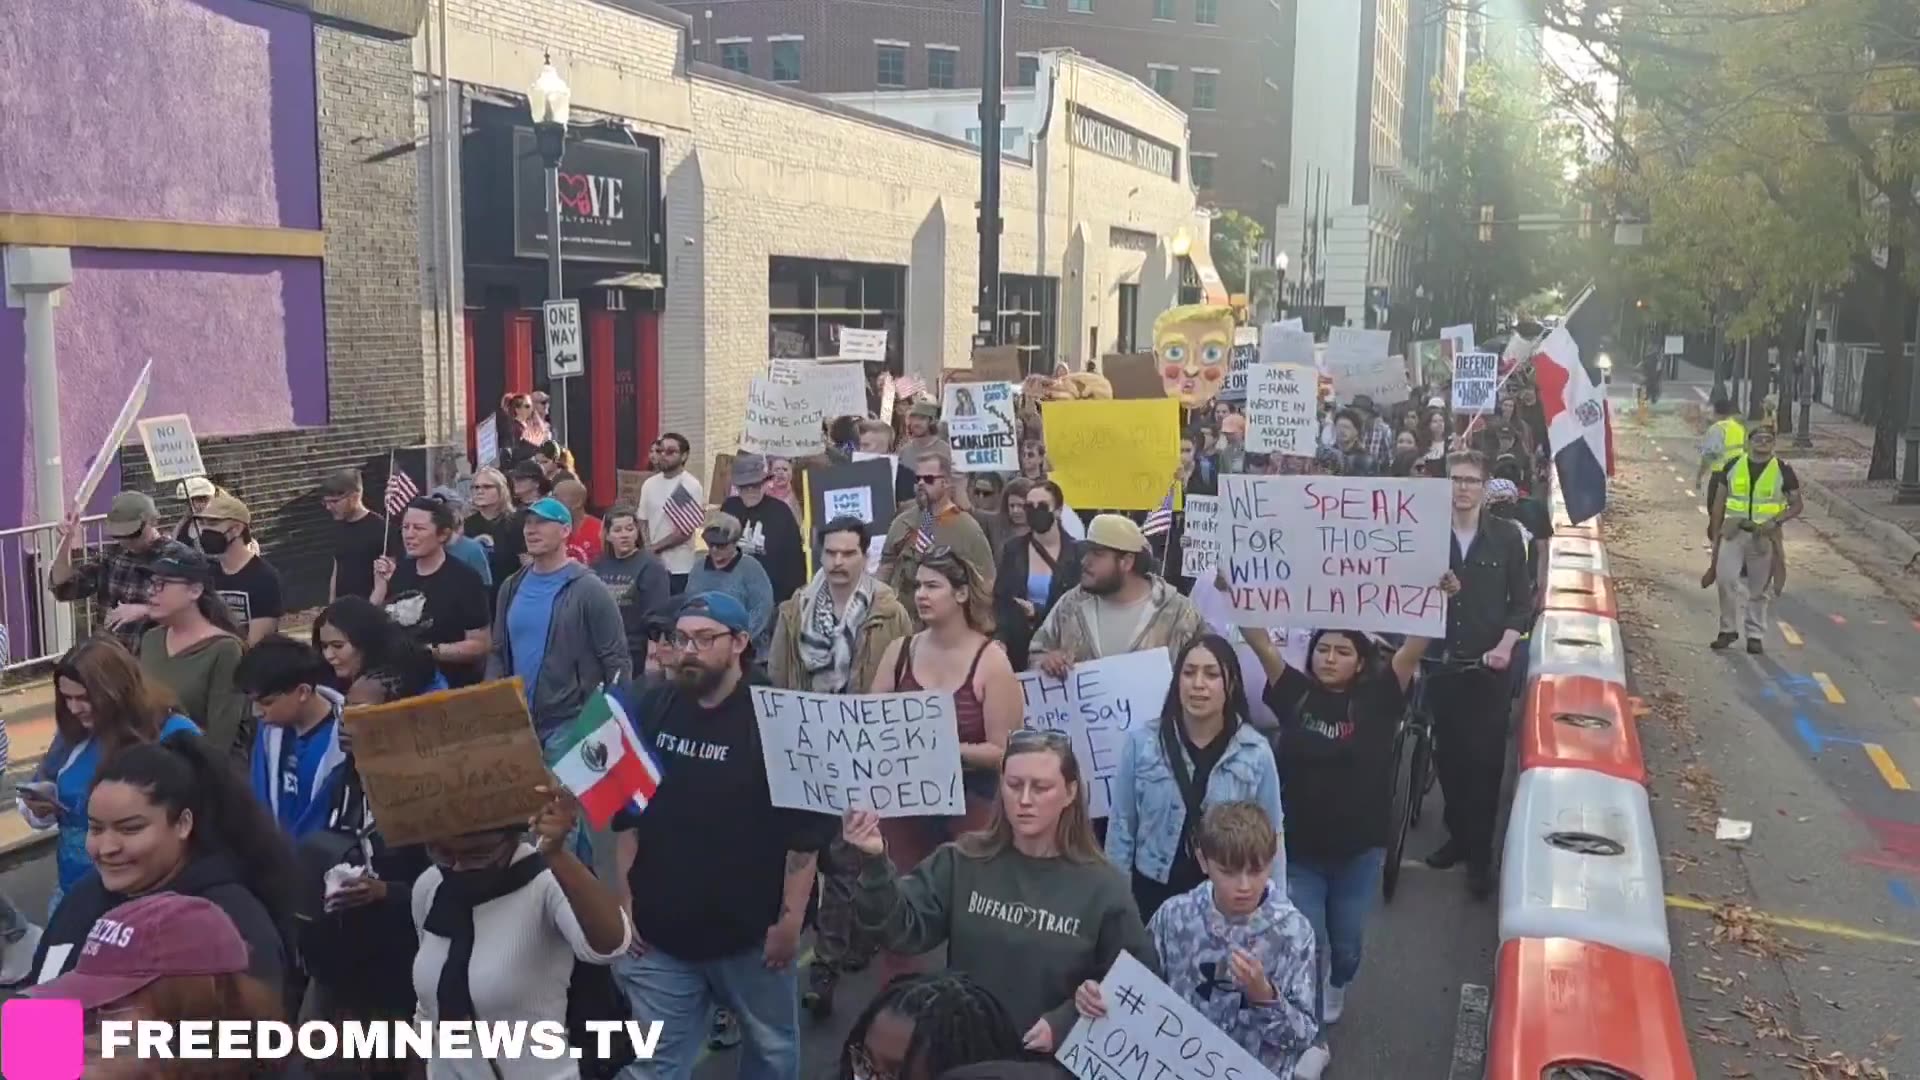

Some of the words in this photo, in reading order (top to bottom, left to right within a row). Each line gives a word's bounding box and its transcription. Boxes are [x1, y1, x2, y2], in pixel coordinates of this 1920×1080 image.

[1071, 112, 1133, 161] NORTHSIDE
[1136, 138, 1174, 177] STATION
[549, 306, 575, 326] ONE
[550, 327, 576, 347] WAY
[1265, 368, 1296, 380] ANNE
[1456, 355, 1495, 370] DEFEND
[1258, 383, 1300, 395] FRANK
[1249, 398, 1289, 412] WROTE
[1293, 401, 1306, 413] IN
[1249, 415, 1273, 425] HER
[1277, 416, 1311, 427] DIARY
[1261, 427, 1296, 437] ABOUT
[1262, 437, 1296, 451] THIS!
[1227, 480, 1277, 521] WE
[1231, 525, 1285, 554] FOR
[1315, 526, 1416, 553] THOSE
[1229, 557, 1291, 585] WHO
[1322, 556, 1392, 577] CANT
[1229, 586, 1291, 612] VIVA
[1306, 585, 1345, 614] LA
[1357, 582, 1446, 623] RAZA
[1017, 670, 1107, 707] THE
[758, 689, 785, 718] IF
[797, 696, 829, 723] IT
[839, 695, 942, 725] NEEDS
[656, 732, 677, 752] IT'S
[676, 738, 697, 757] ALL
[699, 742, 730, 762] LOVE
[798, 724, 813, 749] A
[852, 755, 920, 781] NOT
[802, 772, 956, 812] NEEDED!
[968, 890, 1023, 925] BUFFALO
[1037, 908, 1081, 937] TRACE
